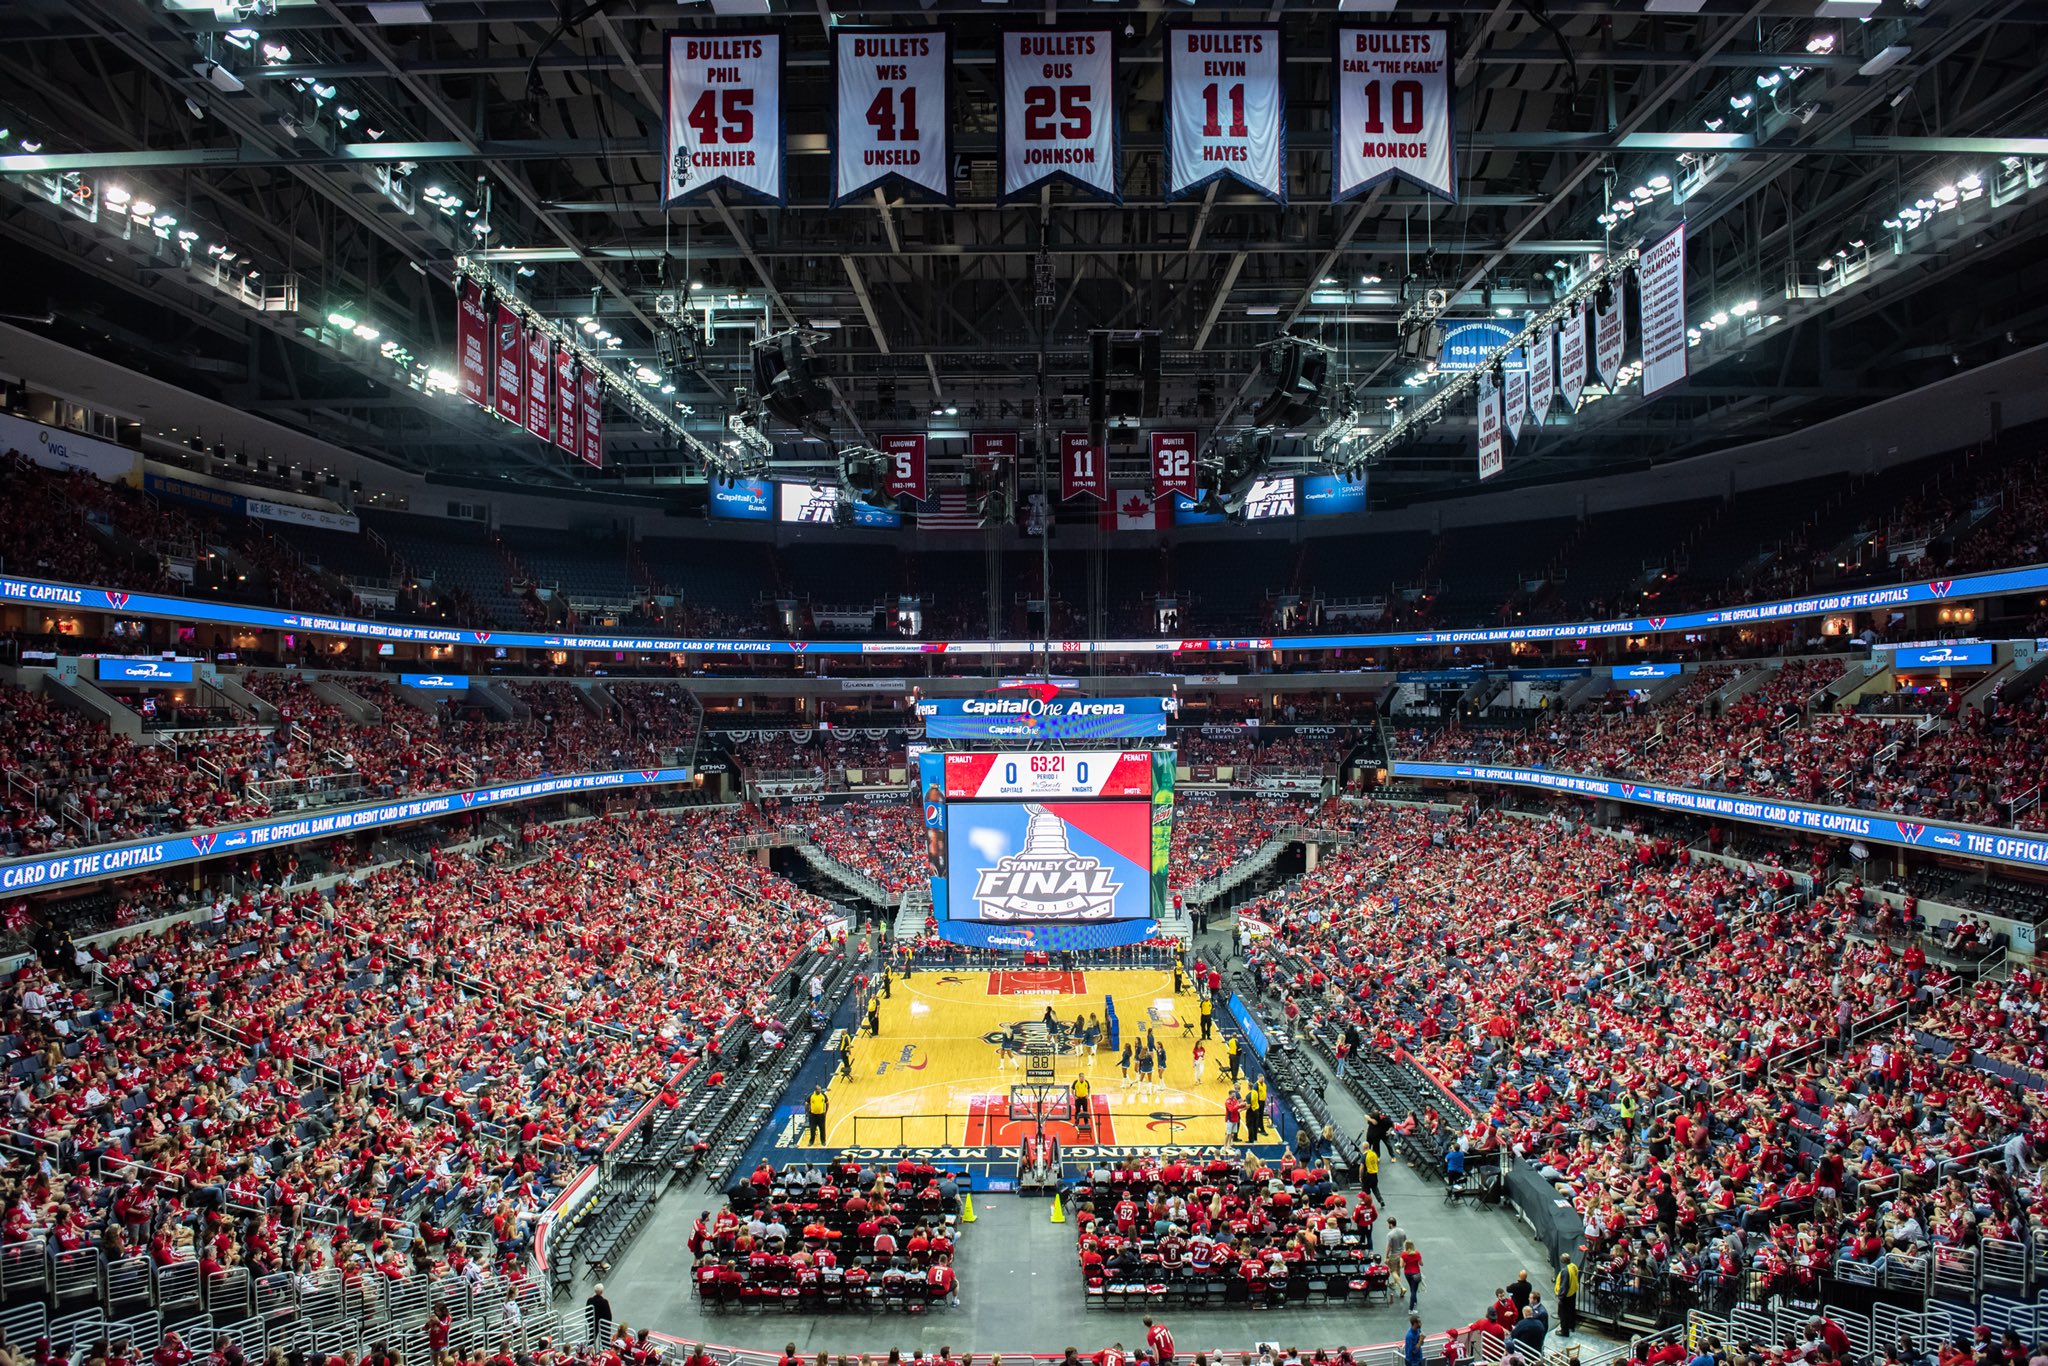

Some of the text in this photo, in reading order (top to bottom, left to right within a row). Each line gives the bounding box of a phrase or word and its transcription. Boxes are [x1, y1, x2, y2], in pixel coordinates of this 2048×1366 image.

[687, 39, 762, 60] BULLETS
[854, 38, 929, 57] BULLETS
[1020, 36, 1095, 55] BULLETS
[1187, 34, 1263, 53] BULLETS
[1356, 34, 1431, 53] BULLETS
[876, 64, 907, 80] WES
[1043, 63, 1072, 79] GUS
[1204, 60, 1246, 77] ELVIN
[1343, 59, 1370, 73] EARL
[707, 67, 741, 83] PHIL
[865, 87, 920, 141] 41
[1024, 85, 1091, 140] 25
[1202, 83, 1248, 137] 11
[1364, 79, 1424, 135] 10
[687, 88, 754, 144] 45
[692, 150, 756, 167] CHENIER
[864, 149, 920, 165] UNSELD
[1024, 148, 1095, 165] JOHNSON
[1203, 145, 1248, 162] HAYES
[1362, 142, 1427, 158] MONROE
[1647, 237, 1675, 265] DIVISION
[1642, 247, 1680, 279] CHAMPIONS
[1451, 345, 1477, 355] 1984
[48, 442, 69, 458] WGL
[890, 439, 916, 448] LANGWAY
[1162, 438, 1185, 446] HUNTER
[895, 452, 912, 479] 5
[1073, 451, 1094, 477] 11
[1158, 450, 1190, 477] 32
[748, 504, 767, 512] Bank
[4, 582, 81, 602] THE CAPITALS
[1720, 589, 1909, 622] THE OFFICIAL BANK AND CREDIT CARD OF THE CAPITALS
[300, 617, 313, 627] THE
[314, 619, 340, 630] OFFICIAL
[403, 628, 413, 638] OF
[414, 629, 428, 639] THE
[429, 631, 461, 641] CAPITALS
[1436, 622, 1633, 642] THE OFFICIAL BANK AND CREDIT CARD OF THE CAPITALS
[563, 638, 577, 646] THE
[578, 639, 611, 648] OFFICIAL
[612, 640, 635, 649] BANK
[636, 641, 652, 649] AND
[654, 641, 680, 649] CREDIT
[682, 642, 702, 650] CARD
[704, 642, 715, 650] OF
[733, 643, 771, 651] CAPITALS
[2014, 649, 2028, 657] 200
[66, 665, 77, 675] 215
[1067, 701, 1125, 715] Arena
[948, 755, 973, 763] PENALTY
[1030, 755, 1065, 772] 63:21
[1123, 754, 1148, 762] PENALTY
[1006, 762, 1017, 784] 0
[1077, 761, 1088, 784] 0
[1474, 769, 1485, 777] THE
[1486, 770, 1513, 780] OFFICIAL
[1514, 772, 1530, 781] BANK
[1585, 781, 1609, 793] CAPITALS
[556, 774, 624, 789] CARD OF THE CAPITALS
[1653, 790, 1870, 834] THE OFFICIAL BANK AND CREDIT CARD OF THE CAPITALS
[251, 798, 449, 844] THE OFFICIAL BANK AND CREDIT CARD OF THE CAPITALS
[1968, 835, 1994, 853] THE
[4, 846, 163, 887] CARD OF THE CAPITALS
[1001, 859, 1096, 871] STANLEY CUP
[981, 872, 1118, 895] FINAL
[1020, 900, 1074, 911] 2018
[841, 1148, 987, 1159] MYSTICS
[1121, 1209, 1132, 1220] 92
[1170, 1249, 1176, 1260] 8
[1194, 1249, 1209, 1261] 77
[1212, 1251, 1228, 1265] 77
[934, 1269, 943, 1281] 8
[1155, 1329, 1170, 1347] 77
[1107, 1355, 1117, 1366] 8
